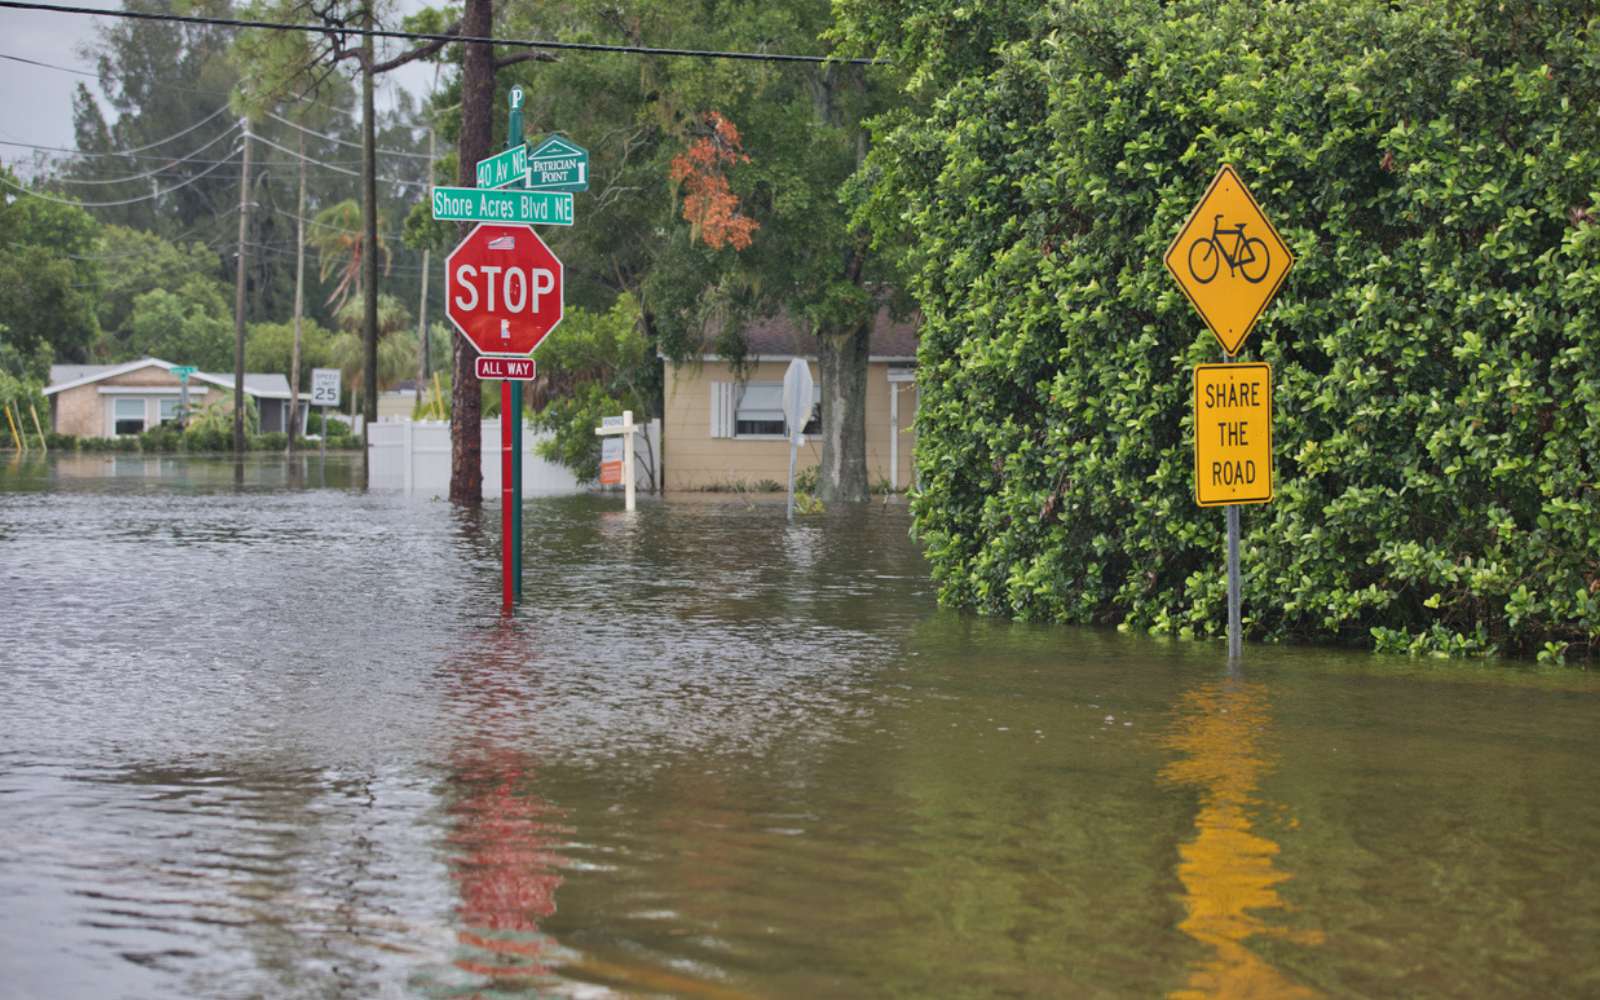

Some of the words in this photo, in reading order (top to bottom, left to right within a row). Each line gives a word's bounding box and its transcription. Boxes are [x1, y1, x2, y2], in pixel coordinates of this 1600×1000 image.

[511, 89, 522, 108] P
[477, 163, 491, 188] 40
[496, 160, 508, 182] Av
[512, 151, 527, 175] NE
[533, 159, 577, 171] PATRICIAN
[542, 171, 568, 183] POINT
[434, 192, 472, 216] Shore
[479, 194, 514, 218] Acres
[521, 195, 548, 219] Blvd
[555, 198, 572, 221] NE
[455, 264, 555, 314] STOP
[482, 361, 502, 375] ALL
[507, 362, 530, 376] WAY
[315, 387, 336, 401] 25
[1205, 382, 1260, 408] SHARE
[1218, 421, 1249, 447] THE
[1212, 460, 1256, 486] ROAD
